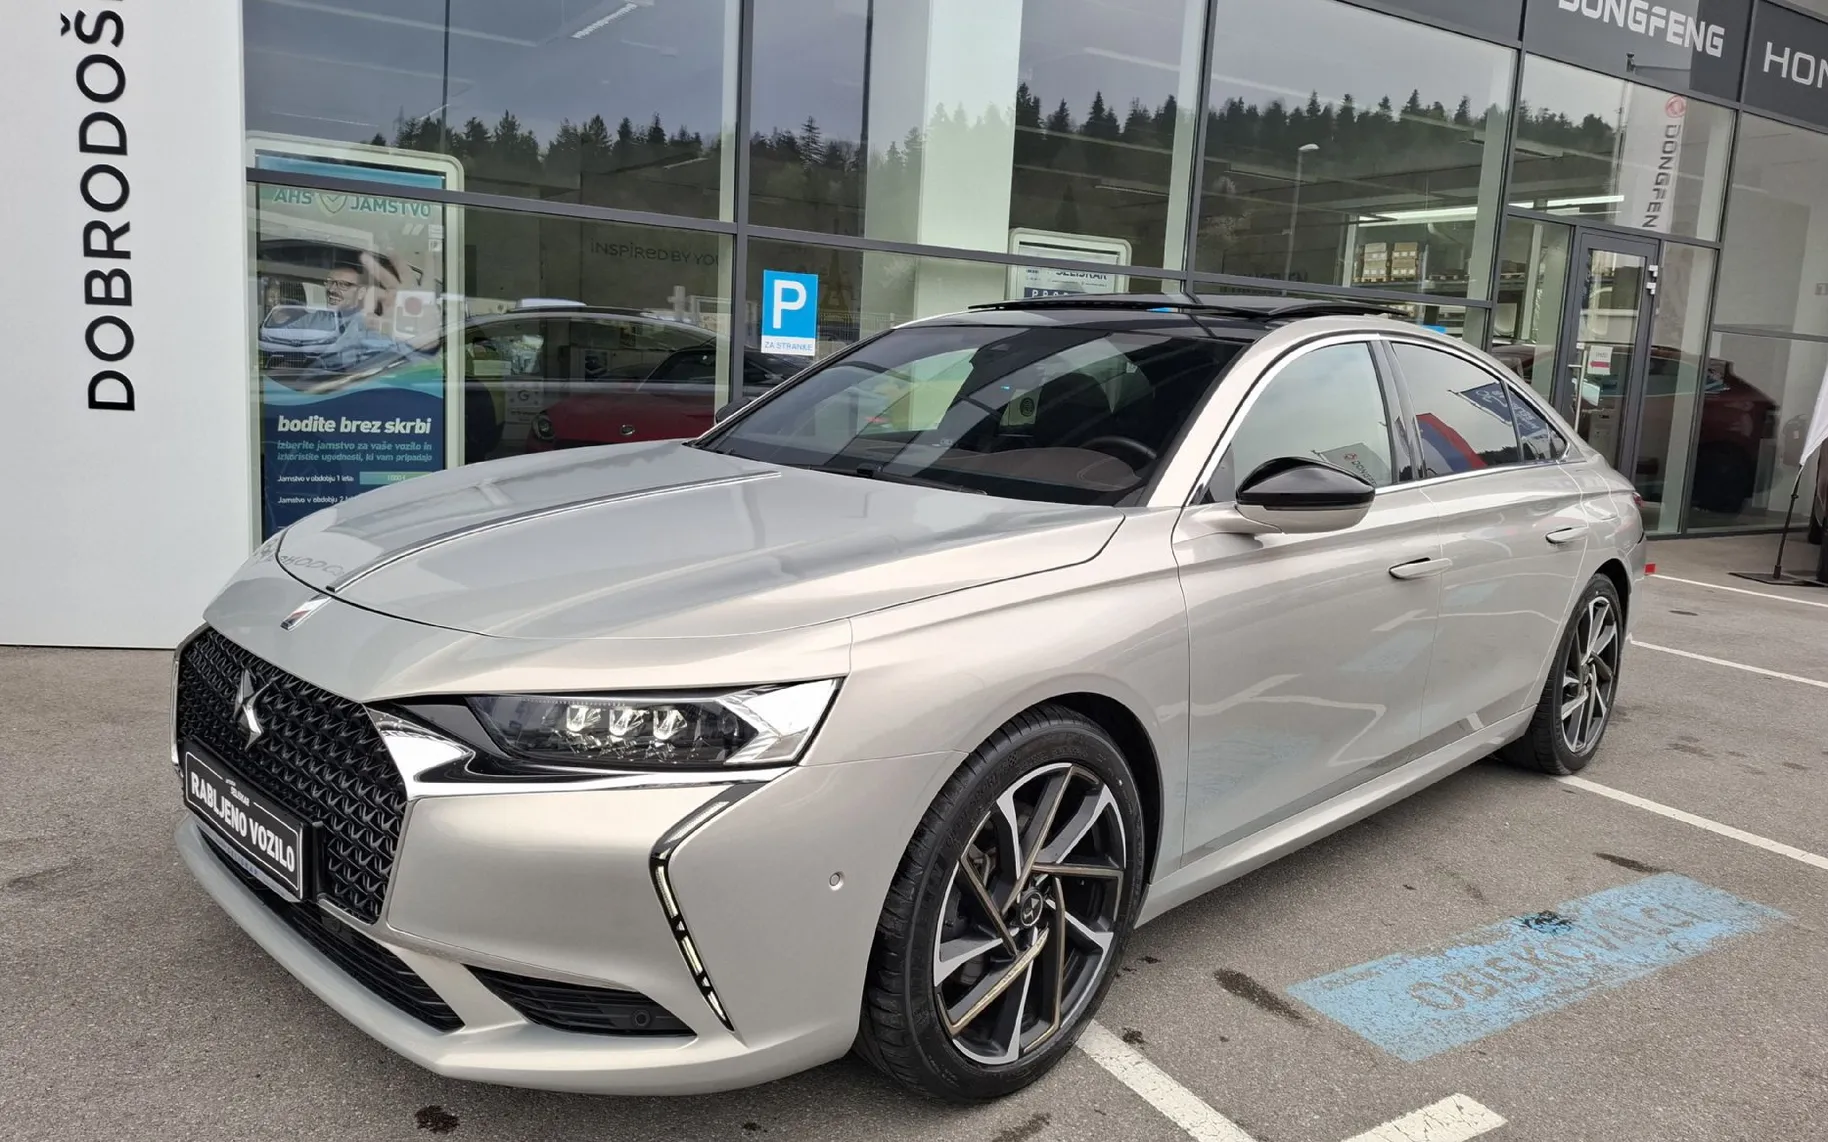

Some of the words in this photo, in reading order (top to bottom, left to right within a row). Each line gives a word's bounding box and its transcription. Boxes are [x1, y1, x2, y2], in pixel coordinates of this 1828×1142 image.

[60, 0, 135, 412] DOBRODOŠ
[274, 188, 312, 205] AHS
[351, 197, 431, 218] JAMSTVO
[671, 250, 691, 263] BY
[773, 279, 807, 329] P
[764, 341, 775, 349] ZA
[775, 342, 813, 351] STRANKE
[277, 415, 335, 432] bodite
[339, 416, 381, 433] brez
[384, 417, 432, 434] skrbi
[316, 440, 355, 452] jamstvo
[371, 441, 393, 450] vaše
[395, 442, 422, 451] vozilo
[423, 442, 432, 451] in
[366, 453, 374, 461] ki
[190, 771, 248, 838] RABLJENO
[249, 818, 296, 873] VOZILO
